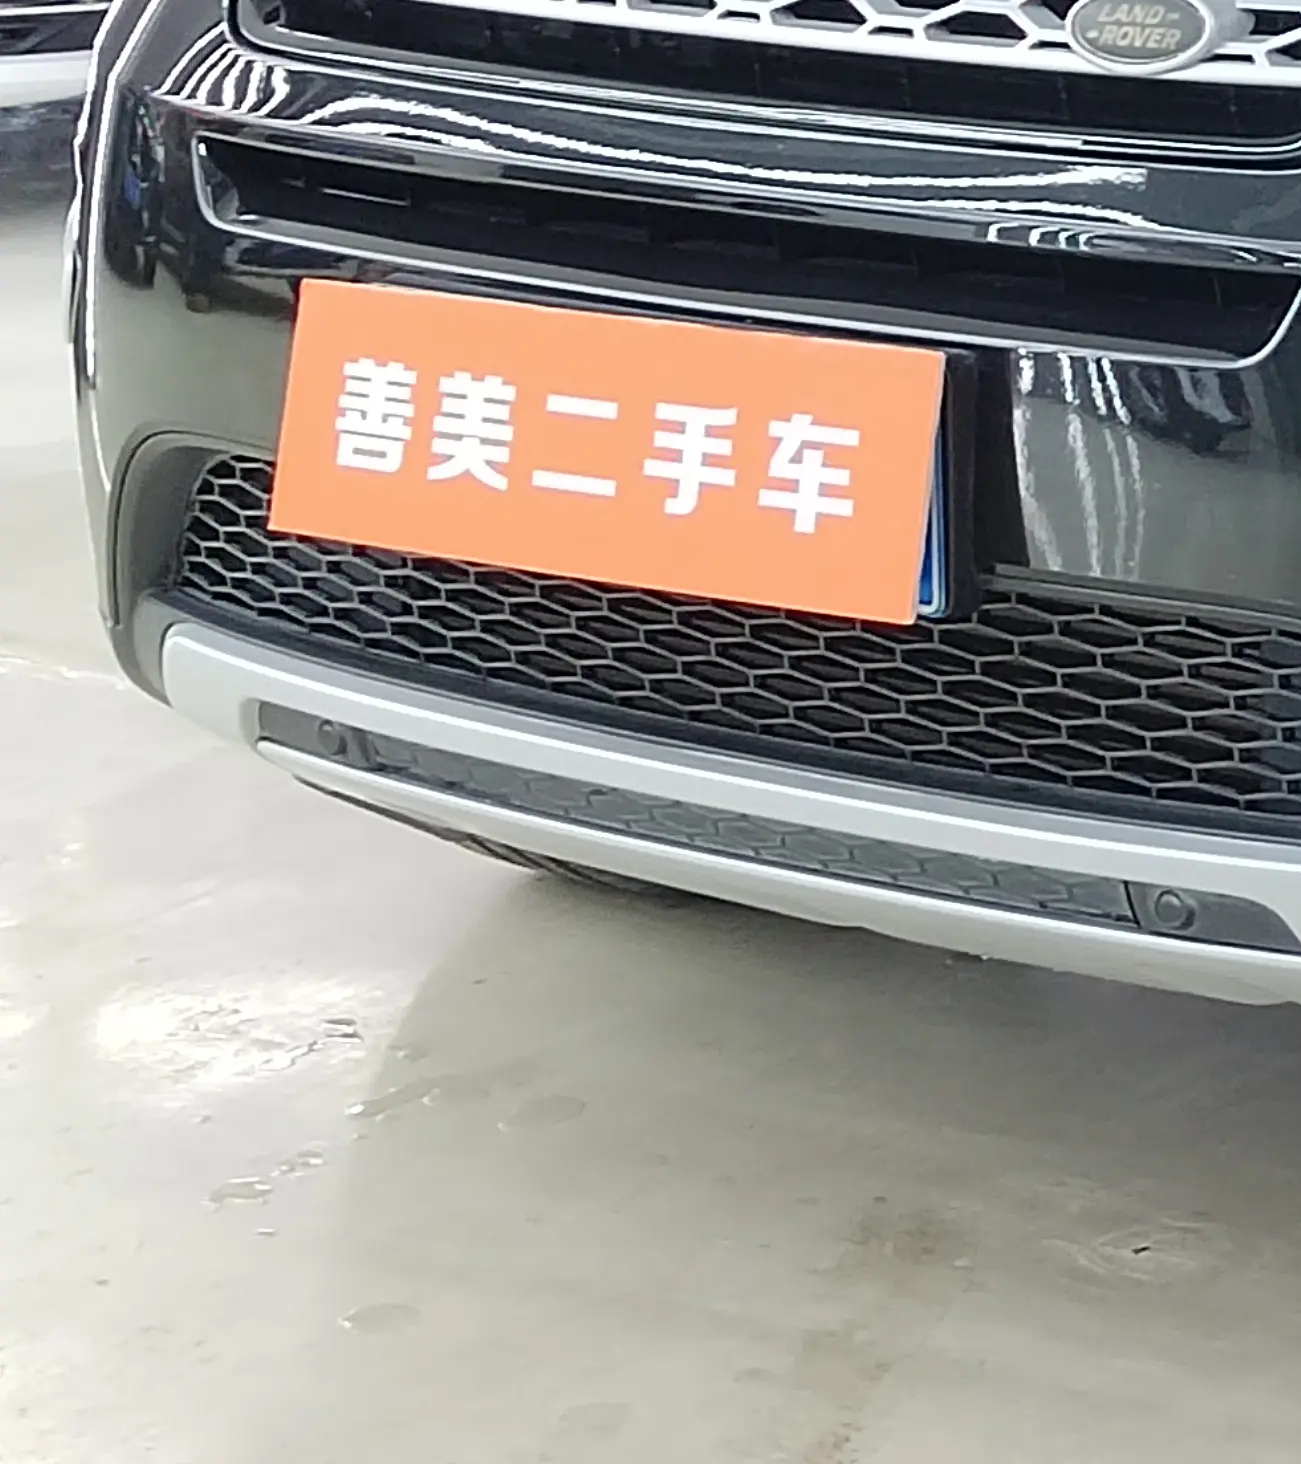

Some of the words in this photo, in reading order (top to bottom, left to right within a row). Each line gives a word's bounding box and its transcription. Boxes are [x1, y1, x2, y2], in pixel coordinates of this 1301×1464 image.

[335, 357, 862, 535] 善美二手车
